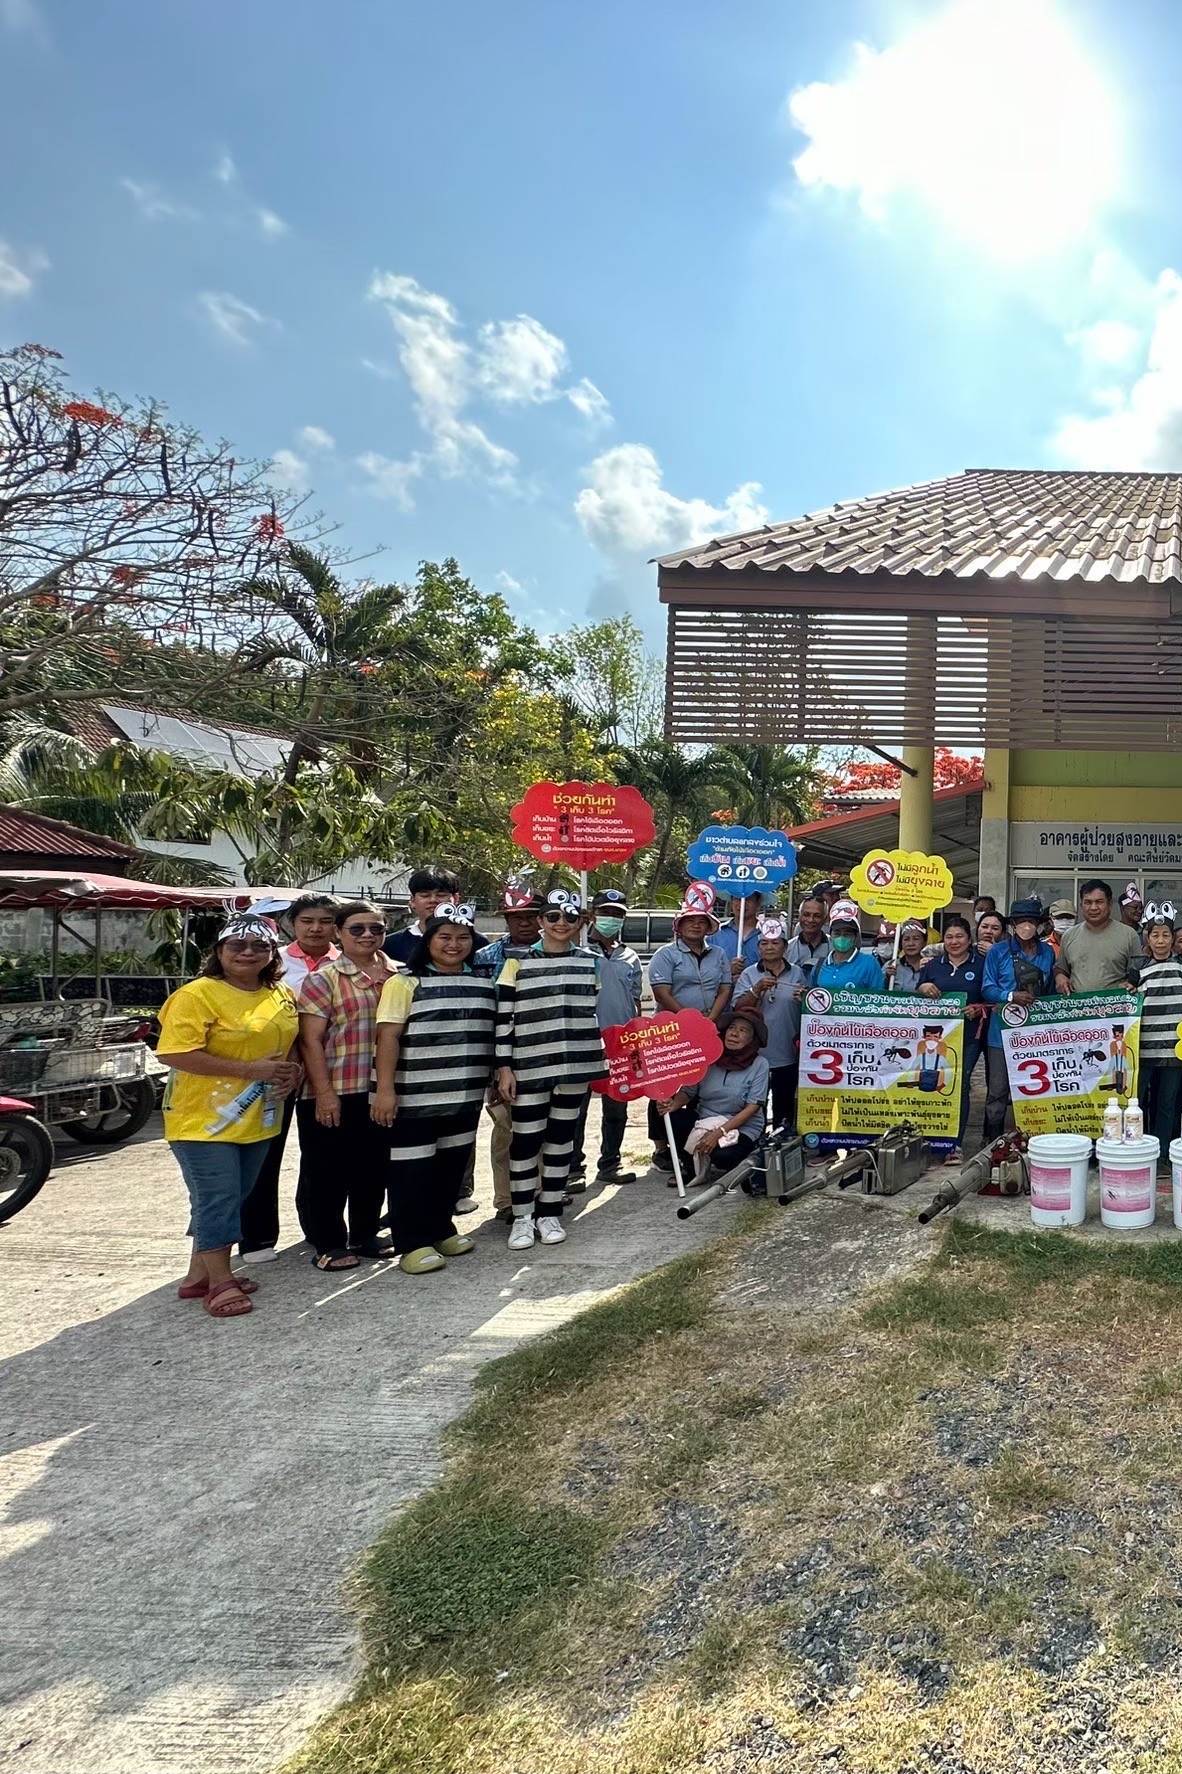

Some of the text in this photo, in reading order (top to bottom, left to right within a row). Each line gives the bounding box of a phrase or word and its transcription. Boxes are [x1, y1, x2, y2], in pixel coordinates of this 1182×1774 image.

[552, 792, 616, 806] ช่วยกันทำ
[1067, 850, 1114, 863] จัดสร้างโดย
[620, 1021, 680, 1044] ช่วยกันทำ
[807, 1019, 918, 1039] ป้องกันไข้เลือดออก
[1009, 1028, 1110, 1049] ป้องกันไข้เลือดออก
[807, 1049, 875, 1086] 3 เก็บ
[846, 1063, 878, 1072] ป้องกัน
[1017, 1056, 1077, 1096] 3 เก็บ
[847, 1072, 875, 1086] โรค
[1053, 1080, 1080, 1093] โรค
